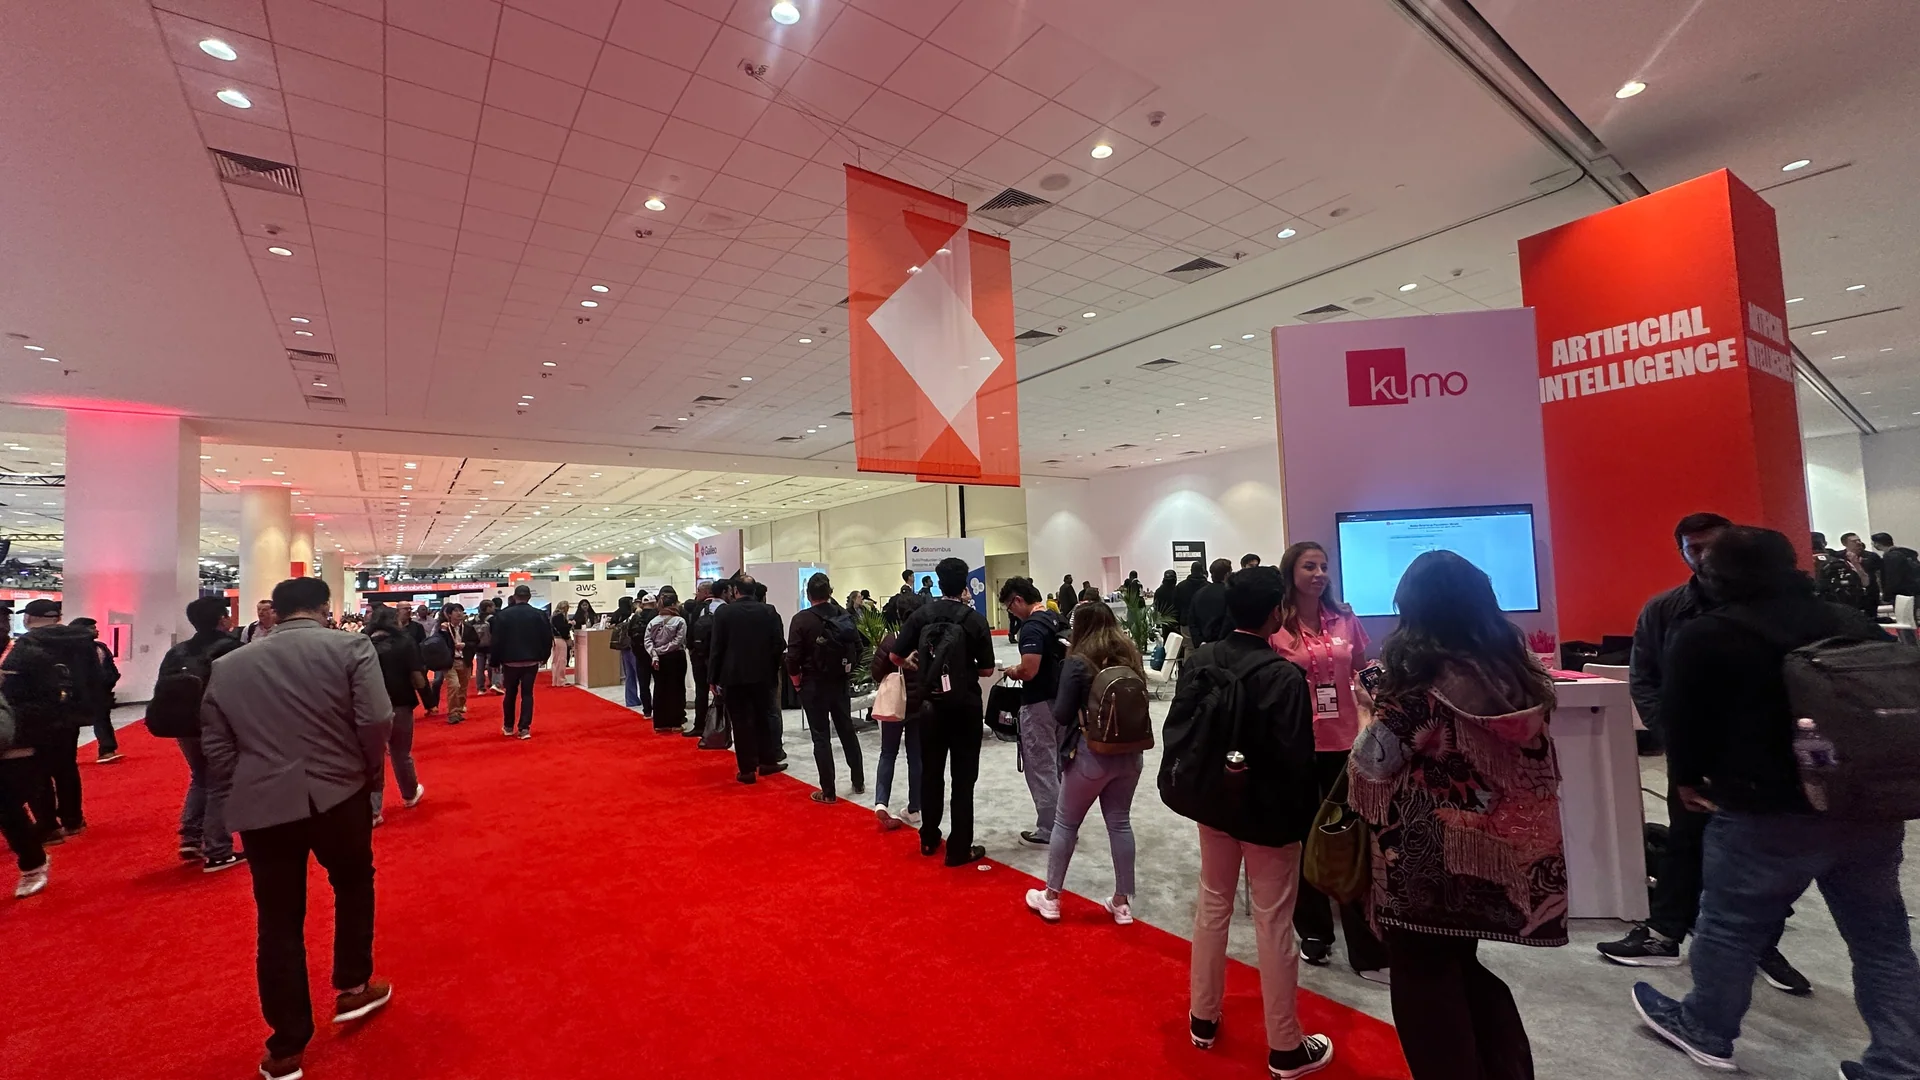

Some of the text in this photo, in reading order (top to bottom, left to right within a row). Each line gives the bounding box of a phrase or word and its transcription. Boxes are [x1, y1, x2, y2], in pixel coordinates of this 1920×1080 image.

[1552, 306, 1711, 367] ARTIFICIAL
[1369, 367, 1468, 400] kumo
[1539, 338, 1739, 404] INTELLIGENCE
[576, 583, 597, 591] aws
